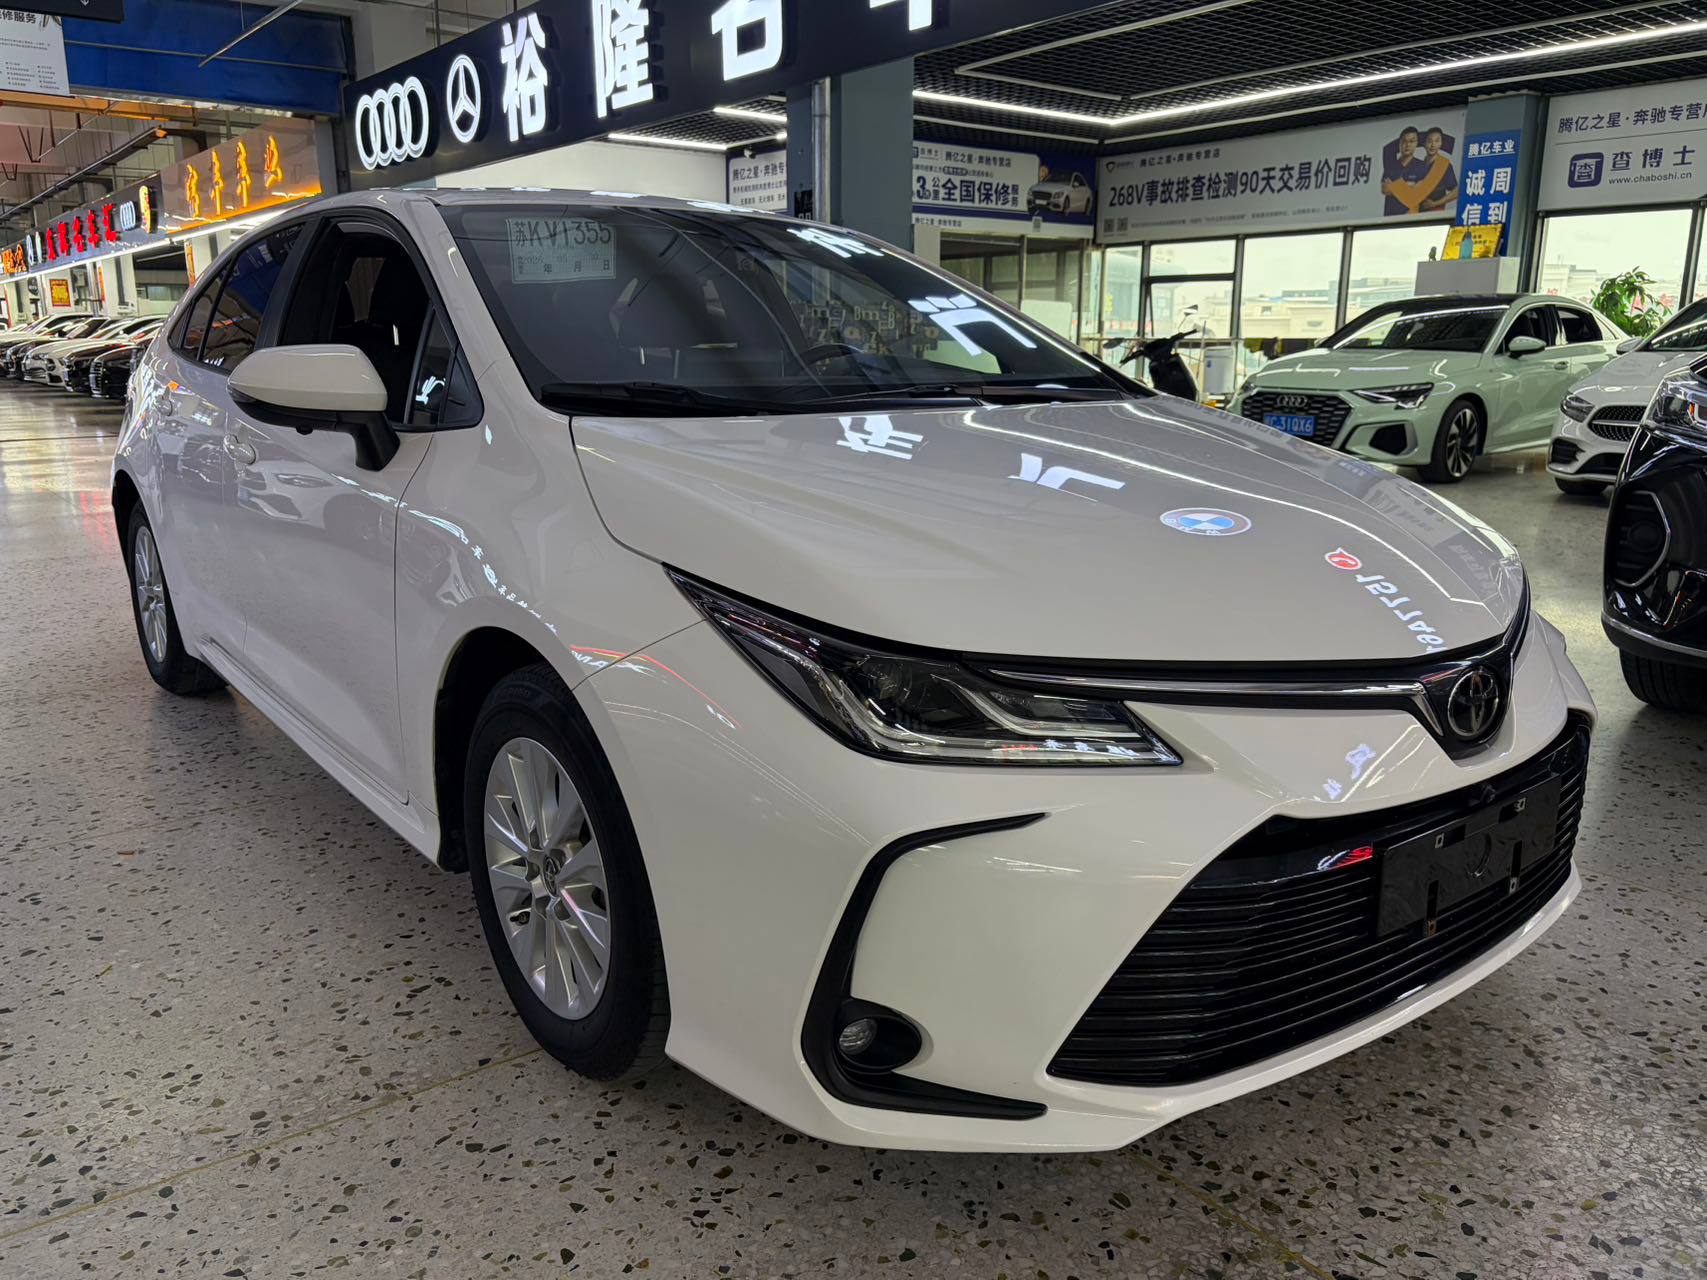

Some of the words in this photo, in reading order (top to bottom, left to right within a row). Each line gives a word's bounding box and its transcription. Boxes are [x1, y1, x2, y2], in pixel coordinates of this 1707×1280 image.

[0, 11, 36, 24] 修服务
[1608, 171, 1693, 185] www.chaboshi.cn
